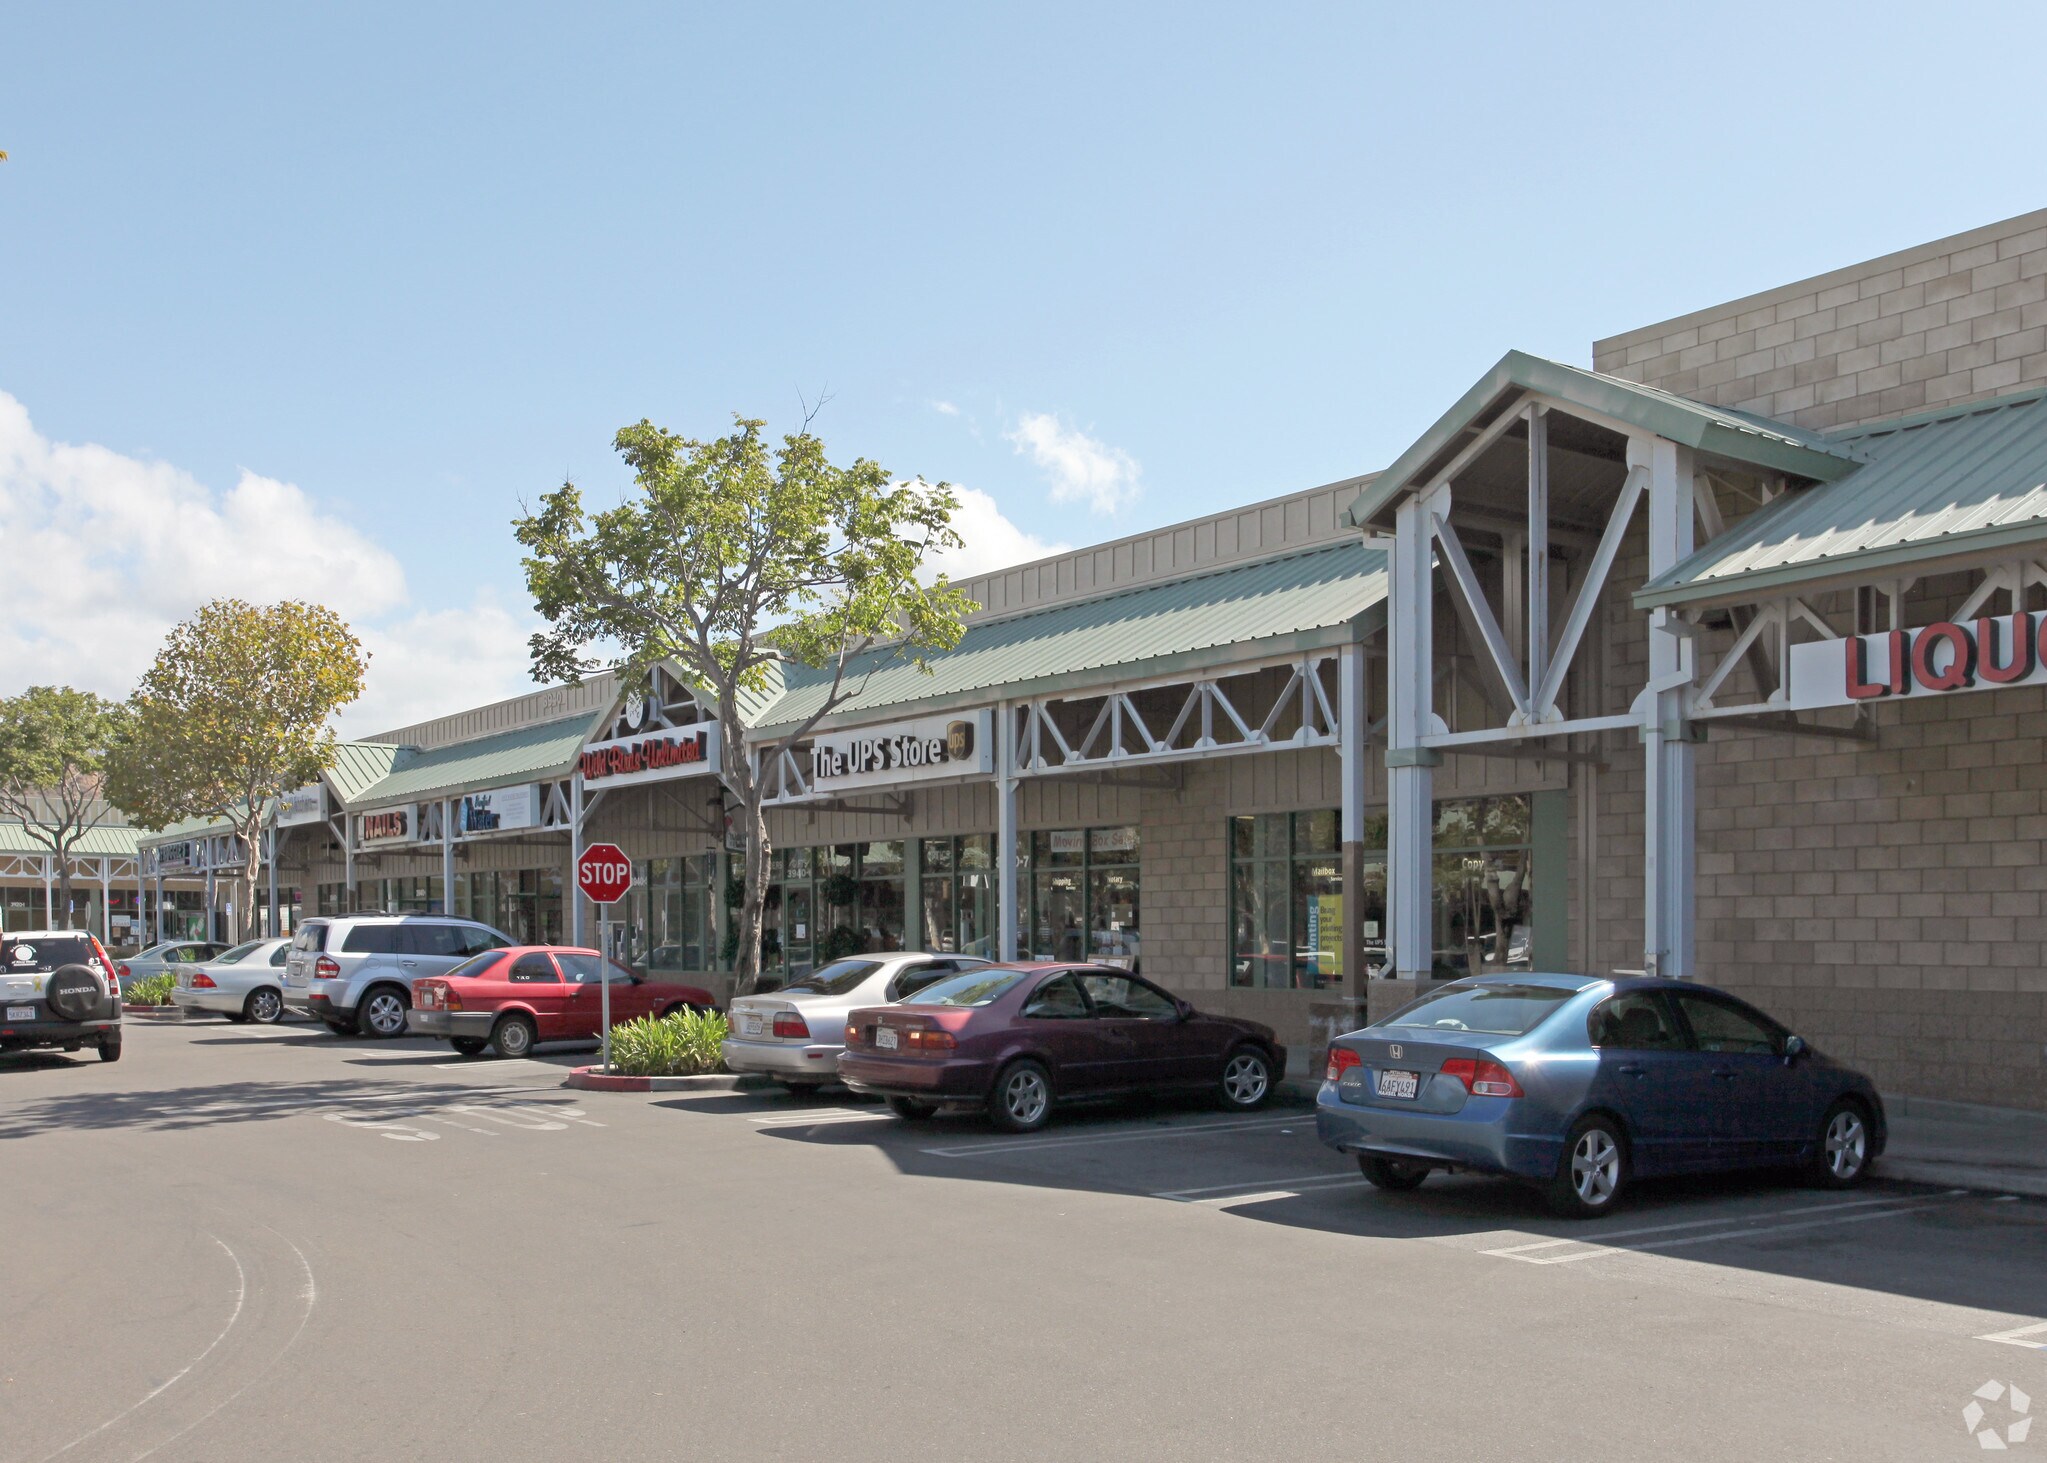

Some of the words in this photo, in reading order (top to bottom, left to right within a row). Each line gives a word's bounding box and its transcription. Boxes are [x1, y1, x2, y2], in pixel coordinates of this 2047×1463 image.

[1845, 611, 2047, 699] LIQU
[950, 732, 965, 749] ups
[578, 748, 613, 780] Wild
[608, 744, 642, 774] Birds
[641, 730, 707, 769] Unlimited
[811, 746, 845, 777] The
[847, 737, 886, 773] UPS
[890, 734, 945, 768] Store
[365, 811, 407, 839] NAILS
[1053, 835, 1083, 849] Movin
[581, 862, 628, 885] STOP
[1311, 867, 1336, 876] Mailbox
[1462, 858, 1485, 872] Copy
[60, 986, 97, 995] HONDA
[1381, 1080, 1415, 1093] 6AFY491
